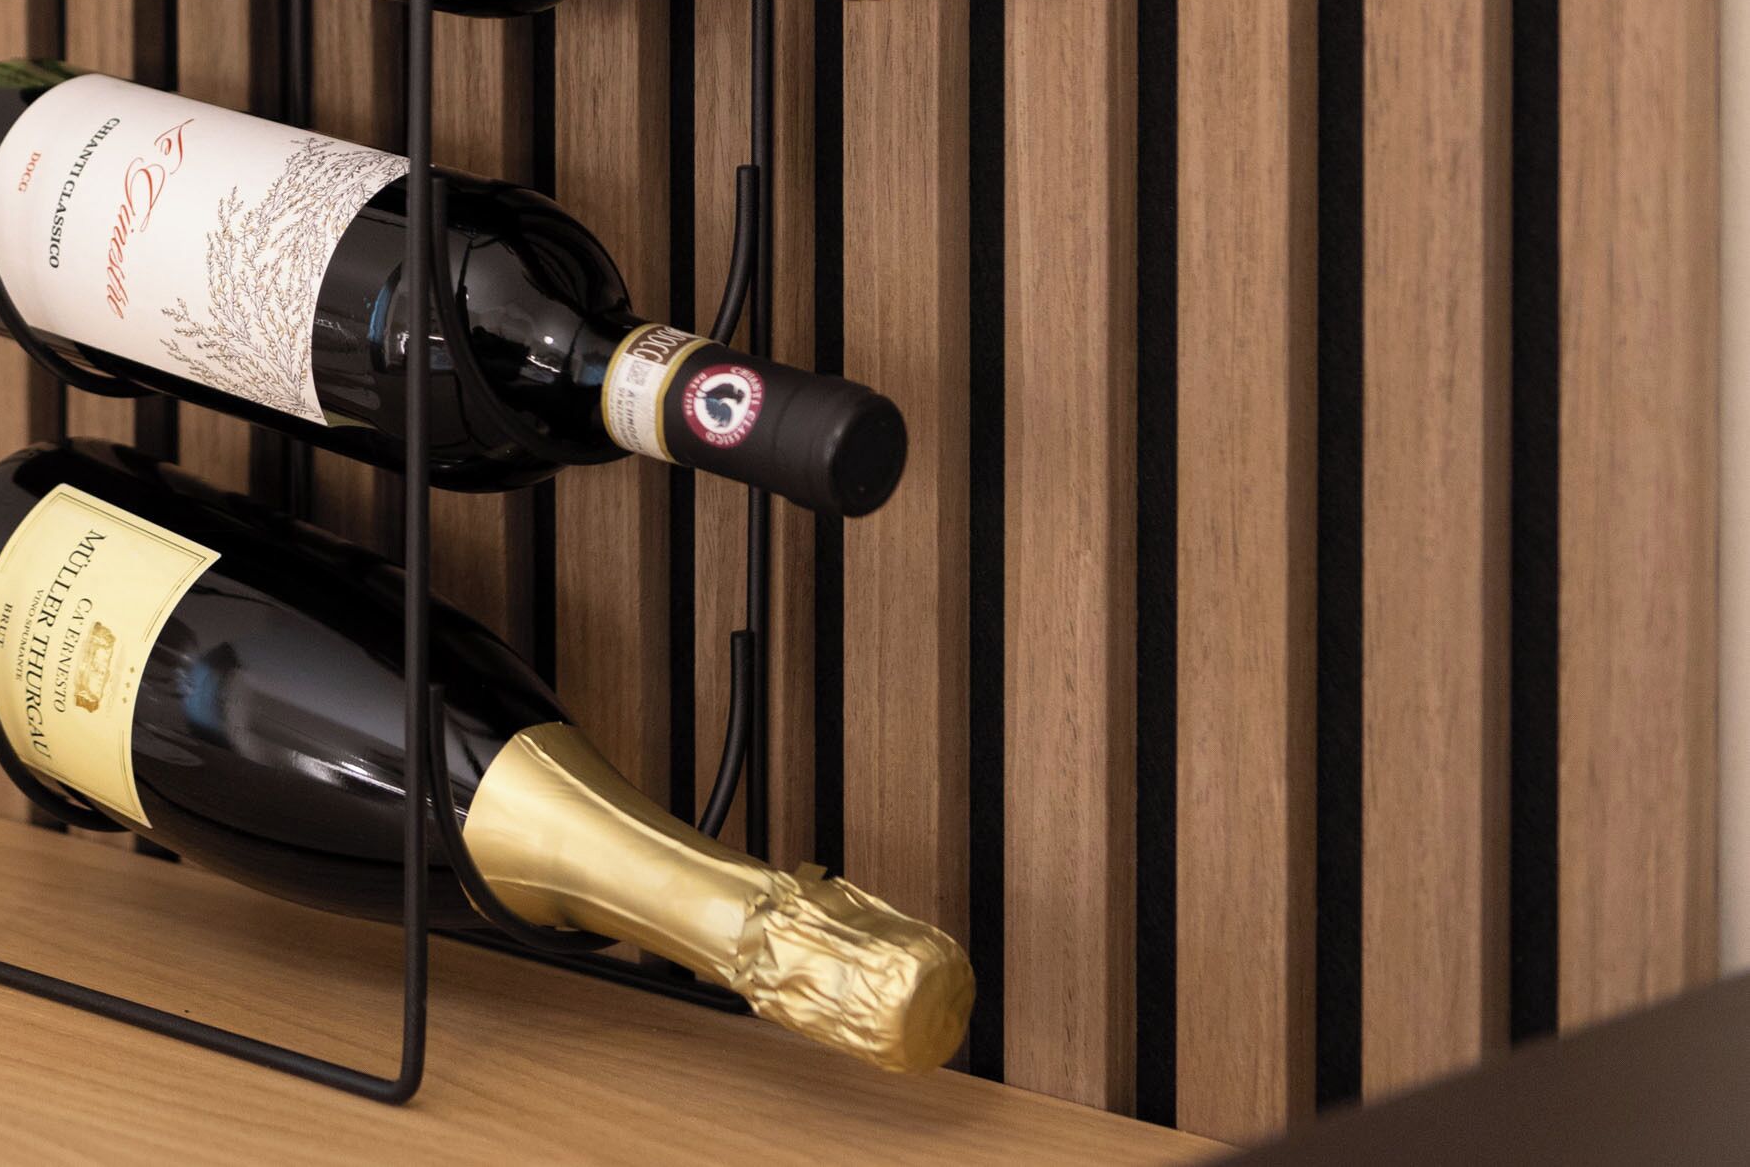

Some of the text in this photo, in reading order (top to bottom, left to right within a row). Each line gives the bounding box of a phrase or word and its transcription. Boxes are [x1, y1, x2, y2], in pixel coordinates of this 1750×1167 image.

[18, 151, 41, 193] DOCG
[50, 117, 120, 269] CHIANTI CLASSICO
[15, 588, 45, 682] VINO SPUMANTE
[25, 529, 106, 759] MÜLLER THURGAU
[53, 629, 82, 713] ERNESTO
